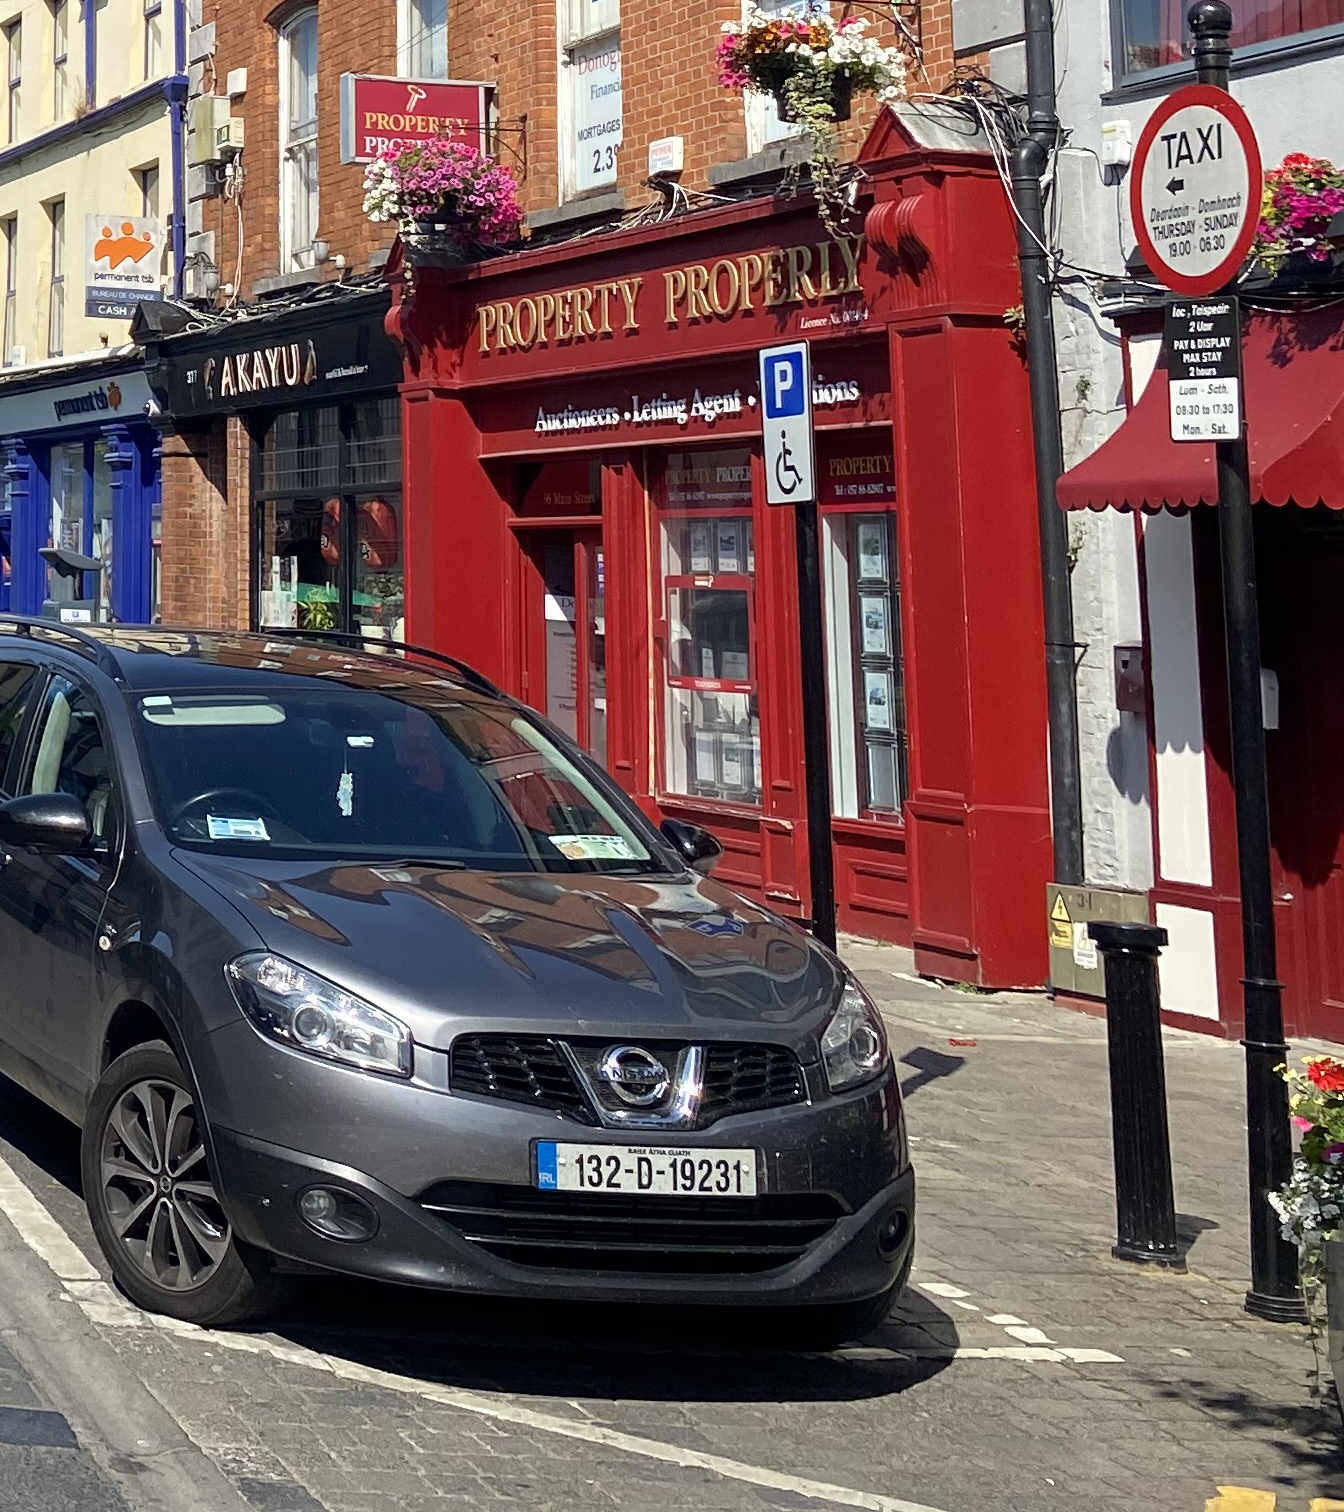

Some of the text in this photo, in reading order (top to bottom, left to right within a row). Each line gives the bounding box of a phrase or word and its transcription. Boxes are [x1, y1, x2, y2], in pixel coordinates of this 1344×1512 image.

[578, 119, 620, 142] MORTGAGES
[1161, 123, 1222, 169] TAXI
[1152, 220, 1196, 241] THURSDAY
[1204, 212, 1239, 232] SUNDAY
[1169, 240, 1191, 258] 19.00
[1199, 234, 1225, 252] 06.30
[94, 272, 140, 283] permanent
[478, 234, 865, 353] PROPERTY PROPERLY
[98, 305, 128, 316] CASH
[1189, 320, 1196, 333] 2
[1173, 339, 1189, 351] PAY
[1197, 337, 1231, 349] DISPLAY
[1182, 351, 1222, 363] MAX STAY
[220, 343, 299, 397] AKAYU
[1189, 366, 1217, 377] 2 hours
[774, 361, 793, 408] P
[535, 404, 619, 432] Auctioneers
[632, 392, 688, 424] Letting
[690, 388, 743, 422] Agent
[829, 455, 891, 477] PROPERTY
[613, 1068, 663, 1081] NISSAN
[575, 1154, 742, 1193] 132-D-19231
